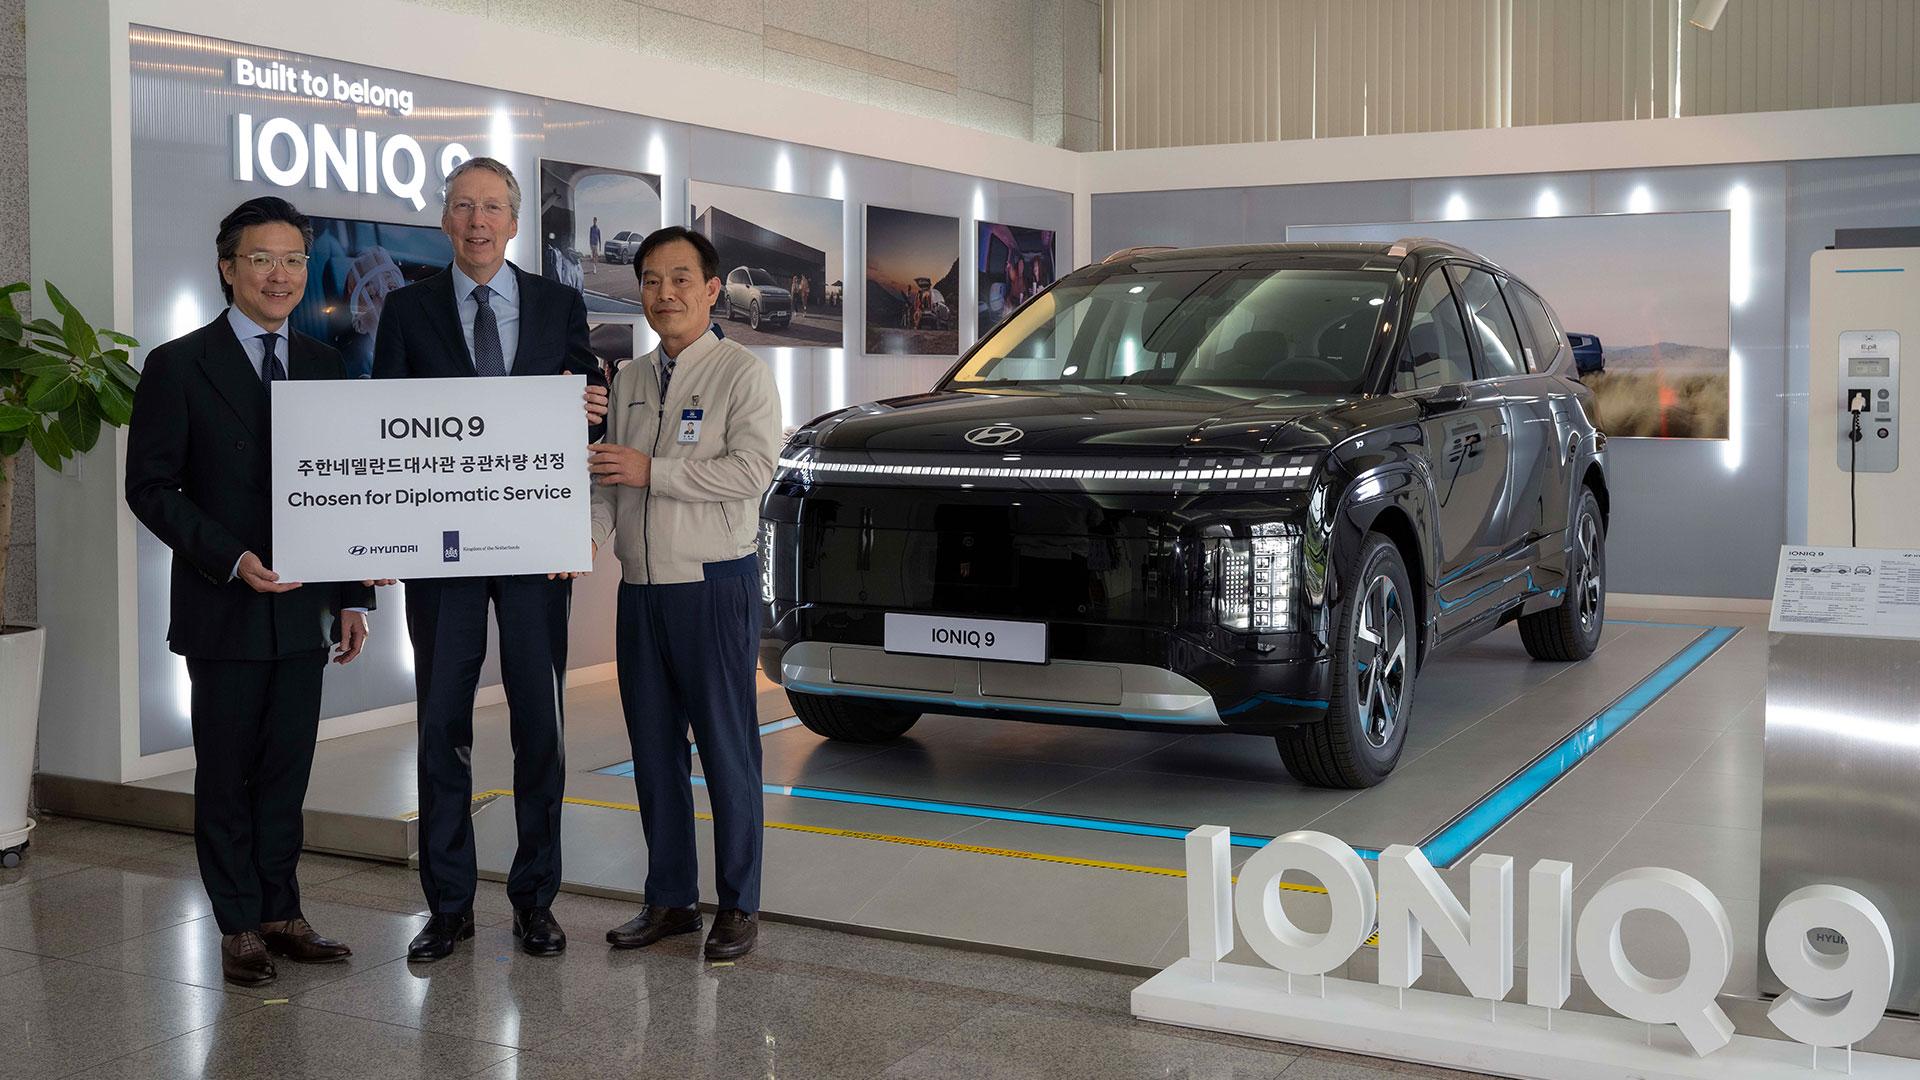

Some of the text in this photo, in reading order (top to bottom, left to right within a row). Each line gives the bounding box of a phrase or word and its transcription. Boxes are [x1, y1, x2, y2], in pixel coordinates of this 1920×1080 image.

[236, 57, 413, 117] Built to belong
[234, 113, 427, 212] IONIQ
[380, 415, 485, 442] IONIQ 9
[297, 452, 565, 477] 주한네델란드대사관 공관차량 선정
[287, 484, 572, 507] Chosen for Diplomatic Service
[370, 544, 418, 555] HYUNDAI
[932, 628, 995, 648] IONIQ 9
[1185, 824, 1894, 1057] IONIQ 9
